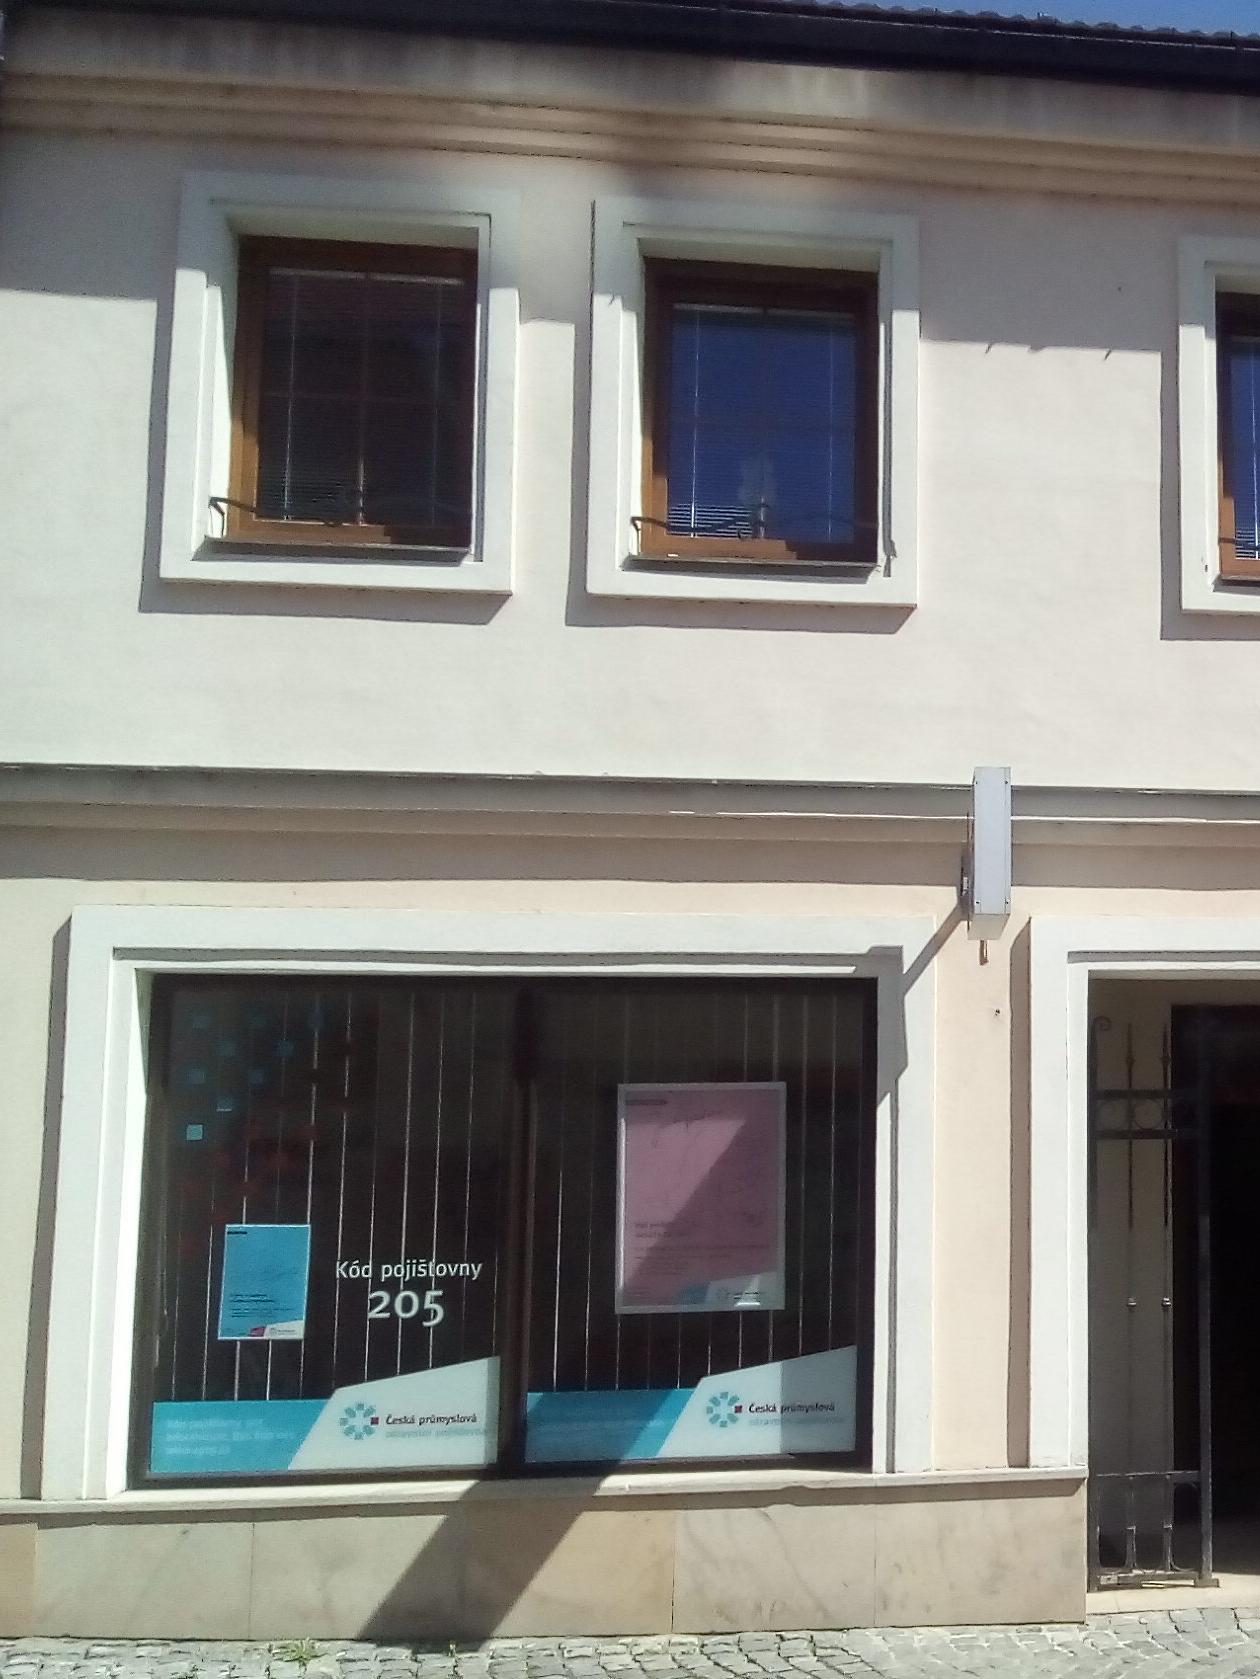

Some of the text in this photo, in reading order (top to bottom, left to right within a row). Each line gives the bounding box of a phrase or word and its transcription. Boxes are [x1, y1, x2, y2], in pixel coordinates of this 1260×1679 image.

[336, 1260, 372, 1278] Kód
[367, 1289, 445, 1327] 205
[749, 1403, 776, 1413] Česká
[386, 1413, 415, 1425] Česká
